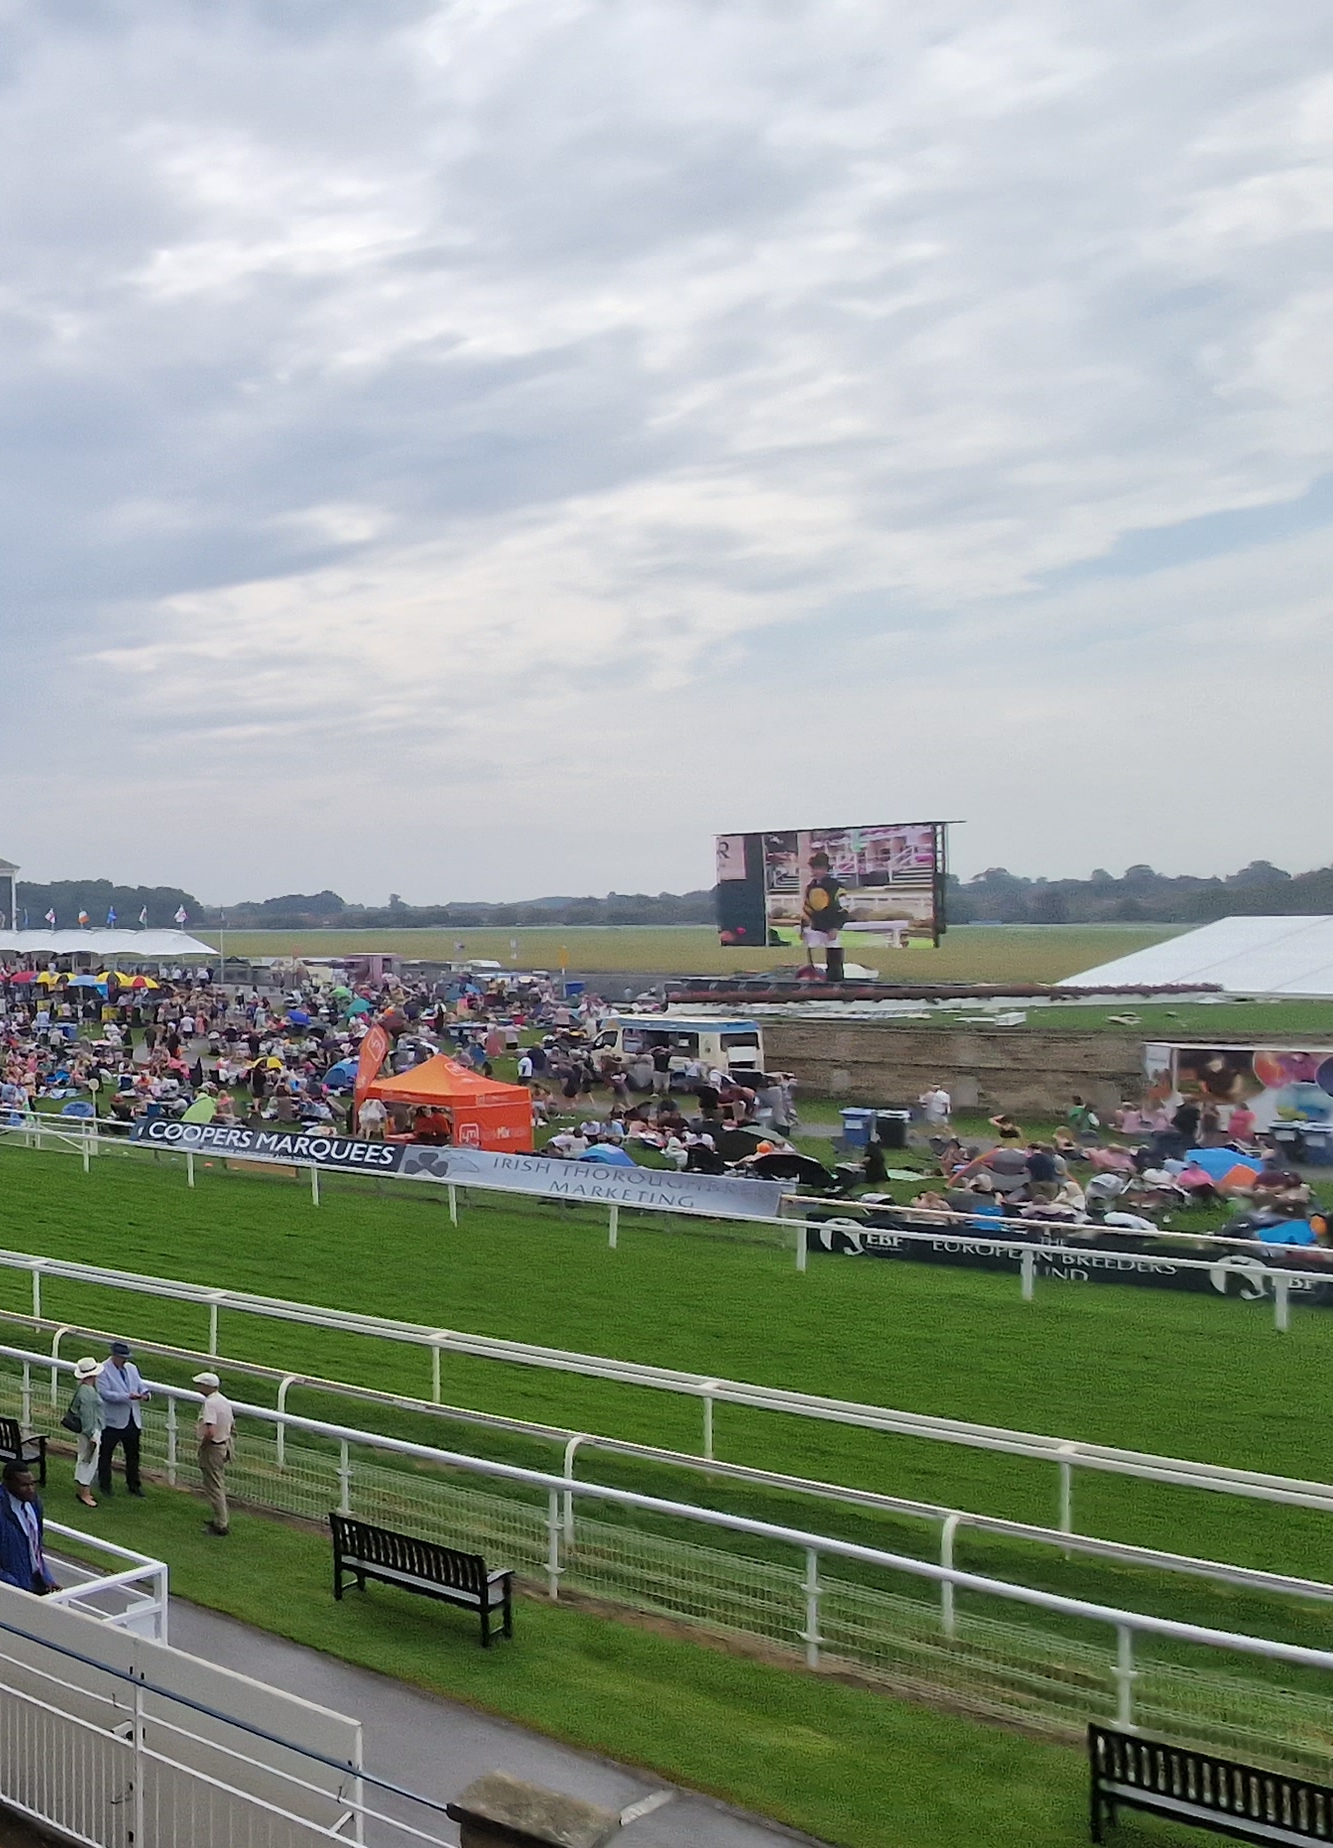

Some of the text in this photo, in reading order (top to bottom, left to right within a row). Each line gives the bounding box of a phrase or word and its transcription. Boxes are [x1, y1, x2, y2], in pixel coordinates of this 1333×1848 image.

[148, 1121, 254, 1148] COOPERS
[255, 1131, 396, 1165] MARQUEES
[493, 1156, 550, 1175] IRISH
[549, 1179, 695, 1208] MARKETING
[866, 1233, 904, 1248] EBF
[1062, 1253, 1178, 1276] BREEDERS
